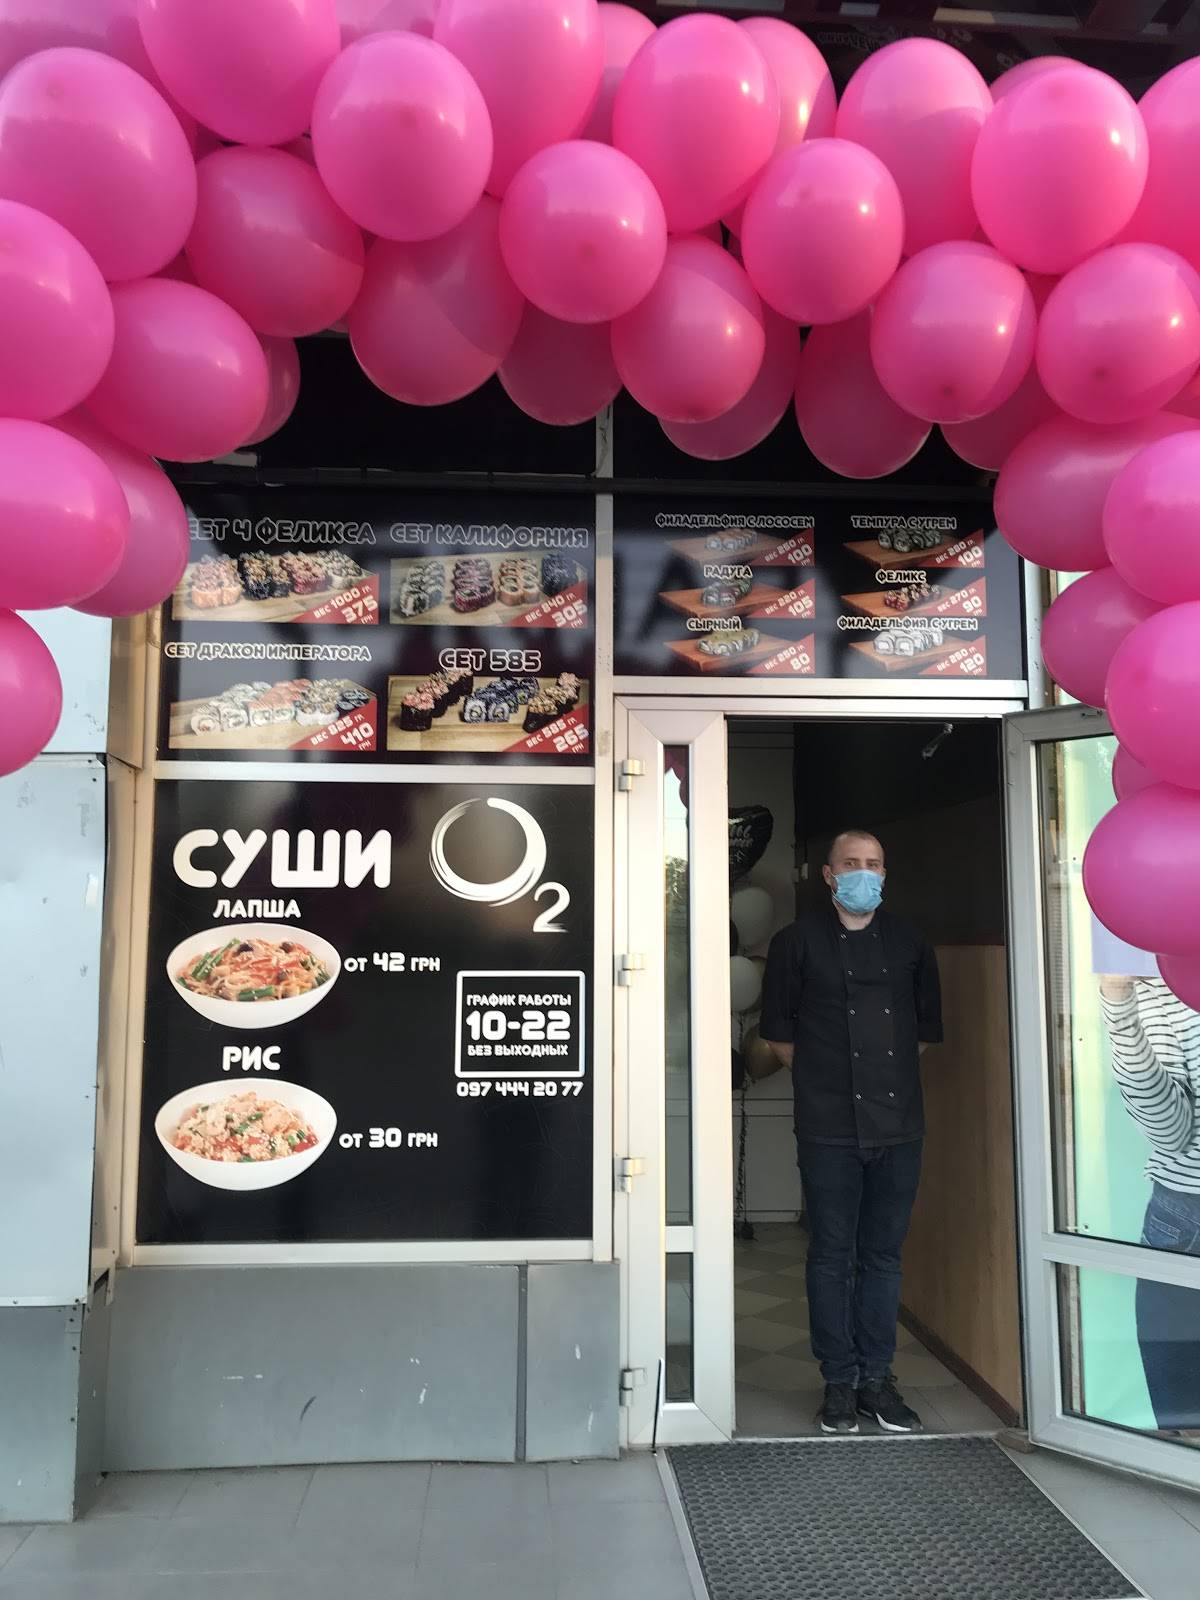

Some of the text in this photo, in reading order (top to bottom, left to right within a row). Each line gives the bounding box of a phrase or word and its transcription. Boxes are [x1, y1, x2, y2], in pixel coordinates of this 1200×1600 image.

[655, 512, 814, 528] ФИЛАДЕЛЬФИЯ С ЛОСОСЕМ
[851, 515, 957, 530] ТЕМПУРА С УГРЕМ
[256, 517, 376, 544] ФЕЛИКСА
[390, 522, 588, 548] СЕТ КАЛИФОРНИЯ
[787, 544, 812, 564] 100
[958, 546, 983, 565] 100
[704, 564, 753, 579] РАДУГА
[875, 569, 926, 584] ФЕЛИКС
[330, 587, 360, 609] 1000
[542, 595, 565, 614] 840
[788, 596, 813, 616] 105
[963, 596, 982, 612] 90
[342, 596, 378, 623] 375
[552, 600, 588, 627] 305
[686, 616, 742, 631] СЫРНЫЙ
[837, 615, 978, 630] ФИЛАДЕЛЬФИЯ С УГРЕМ
[165, 642, 372, 661] СЕТ ДРАКОН ИМПЕРАТОРА
[439, 648, 541, 672] СЕТ 585
[790, 653, 810, 671] 80
[960, 652, 984, 673] 120
[341, 722, 374, 746] 410
[552, 724, 589, 752] 265
[173, 829, 391, 888] СУШИ
[213, 899, 301, 918] ЛАПША
[373, 952, 405, 972] 42
[411, 956, 440, 972] ГРН
[467, 993, 571, 1007] ГРАФИК РАБОТЫ
[466, 1010, 570, 1040] 10-22
[222, 1046, 281, 1070] РИС
[468, 1044, 568, 1057] БЕЗ ВЫХОДНЫХ
[457, 1081, 583, 1096] 097 444 20 77
[368, 1128, 401, 1148] 30
[408, 1132, 437, 1148] ГРН
